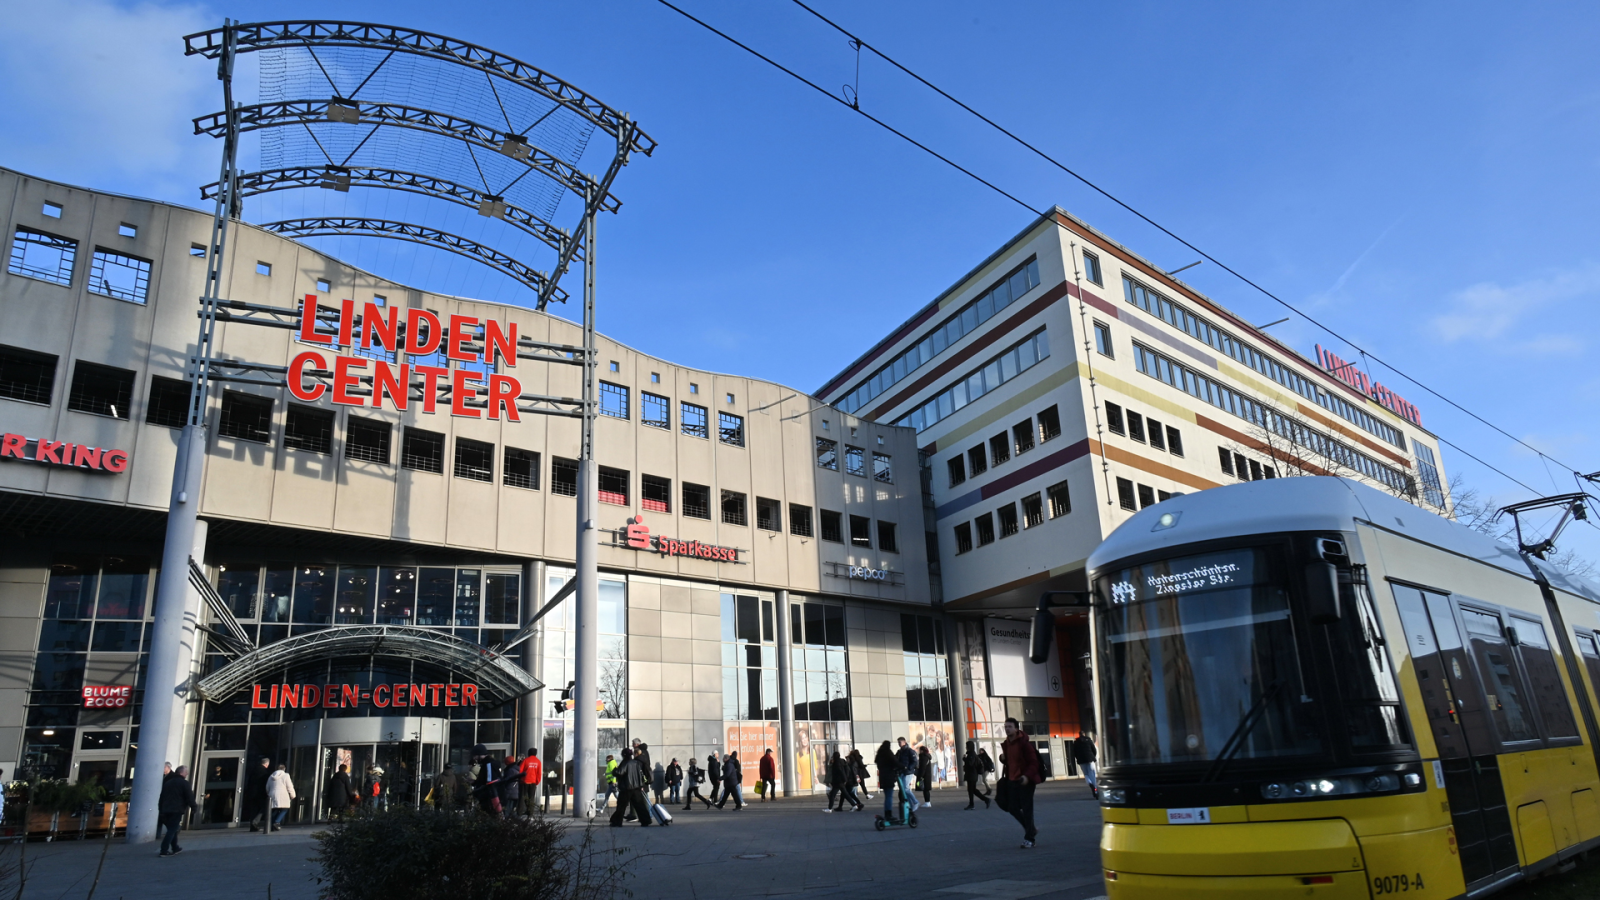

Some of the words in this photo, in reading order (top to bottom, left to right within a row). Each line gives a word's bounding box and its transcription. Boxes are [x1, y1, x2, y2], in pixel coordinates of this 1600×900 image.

[300, 293, 518, 368] LINDEN
[286, 351, 523, 423] CENTER
[1314, 343, 1423, 428] LINDEN-CENTER
[36, 438, 129, 473] KING
[658, 535, 736, 561] Sparkasse
[849, 565, 886, 580] pepco
[1209, 574, 1234, 586] Str.
[1111, 580, 1136, 604] M4
[84, 687, 130, 697] BLUME
[86, 697, 126, 707] 2000
[251, 683, 480, 709] LINDEN-CENTER
[1374, 872, 1425, 895] 9079-A
